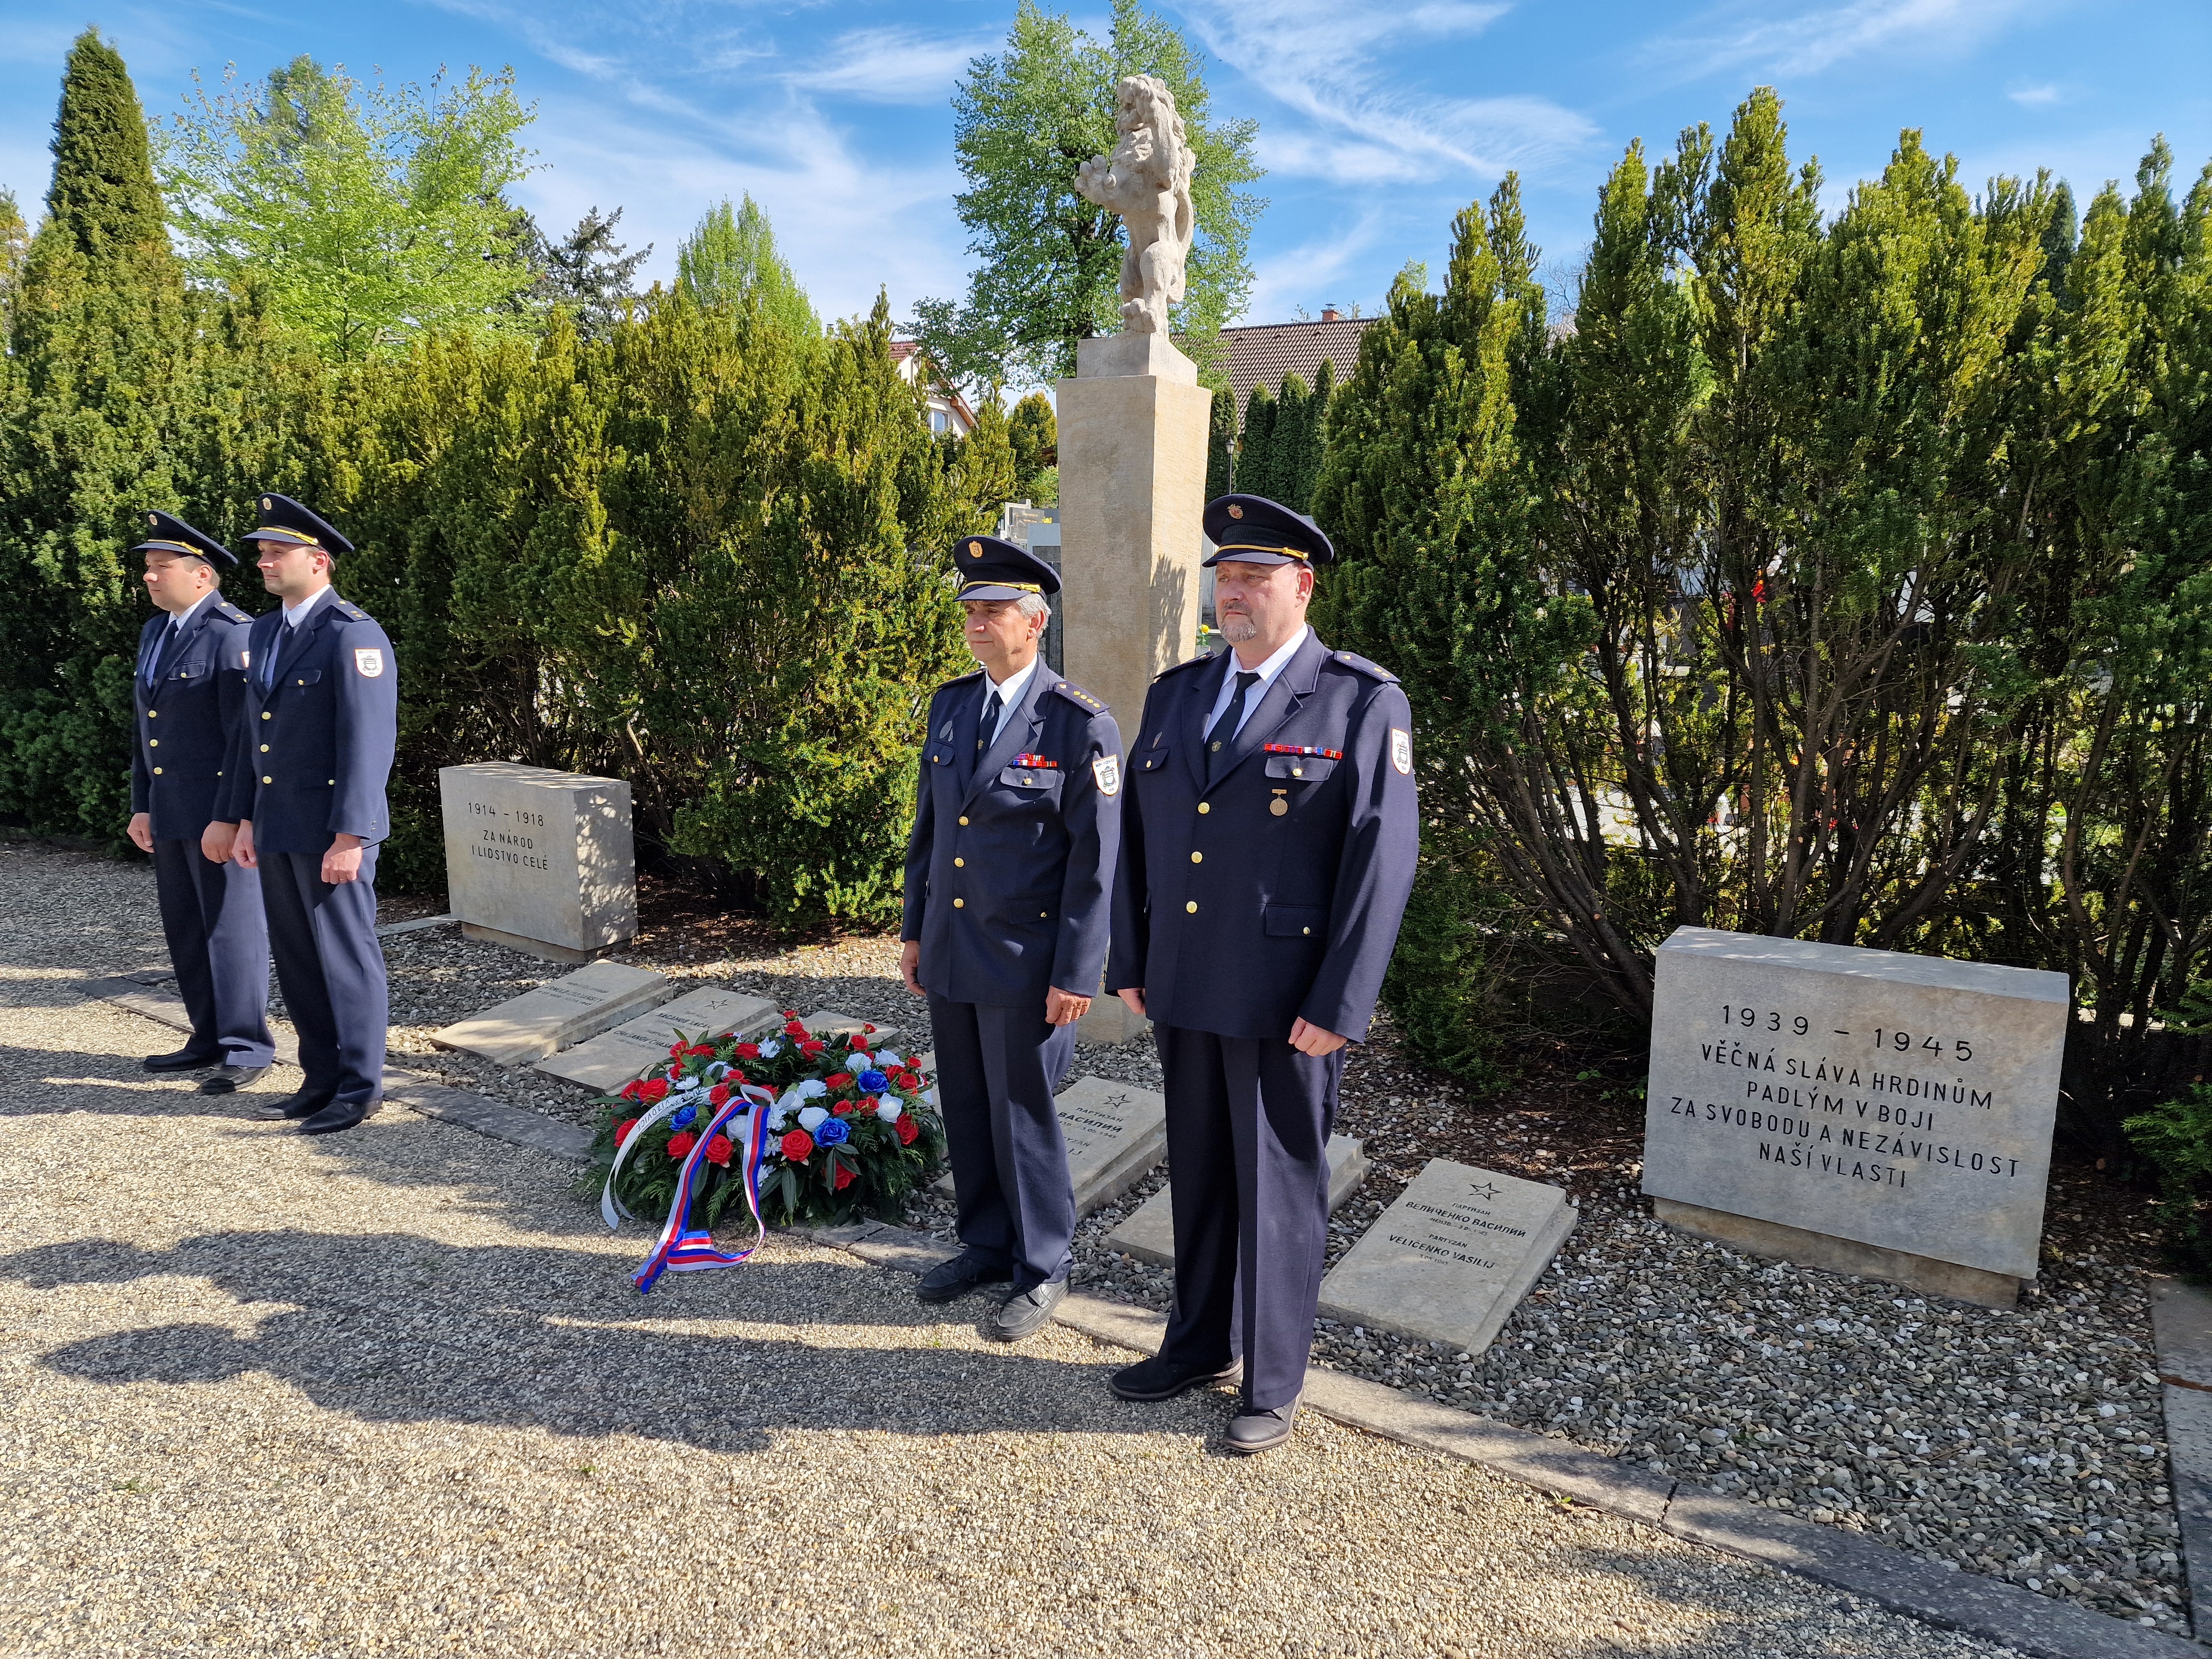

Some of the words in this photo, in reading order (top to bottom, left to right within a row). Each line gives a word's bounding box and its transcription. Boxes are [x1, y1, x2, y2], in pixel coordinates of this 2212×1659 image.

[468, 802, 496, 817] 1914
[516, 810, 544, 827] 1918
[483, 830, 495, 842] ZA
[499, 830, 533, 849] NÁROD
[472, 845, 474, 855] I
[478, 847, 518, 864] LIDSTVO
[523, 855, 548, 870] CELÉ
[649, 1038, 674, 1048] CHASA
[1722, 1004, 1809, 1036] 1939
[1874, 1027, 1973, 1062] 1945
[1702, 1039, 1776, 1073] VĚČNÁ
[1785, 1057, 1861, 1088] SLÁVA
[1872, 1072, 1992, 1110] HRDINŮM
[637, 1099, 670, 1132] VIZOVICE
[1076, 1107, 1124, 1122] ПАРТИЗАН
[1746, 1081, 1844, 1116] PADLÝM
[1856, 1099, 1867, 1118] V
[1879, 1105, 1933, 1131] BOJI
[1057, 1112, 1123, 1133] ВАСИЛИЙ
[1670, 1096, 1697, 1118] ZA
[1706, 1104, 1811, 1139] SVOBODU
[1819, 1124, 1832, 1144] A
[1843, 1128, 2020, 1178] NEZÁVISLOST
[1759, 1141, 1813, 1170] NAŠÍ
[1821, 1154, 1907, 1188] VLASTI
[1405, 1202, 1470, 1222] ВЕЛИЧЕНКО
[1472, 1218, 1526, 1237] ВАСИЛИЙ
[1452, 1203, 1490, 1215] ПАРТИЗАН
[1428, 1234, 1467, 1248] PARTYZÁN
[1453, 1252, 1495, 1269] VASILIJ
